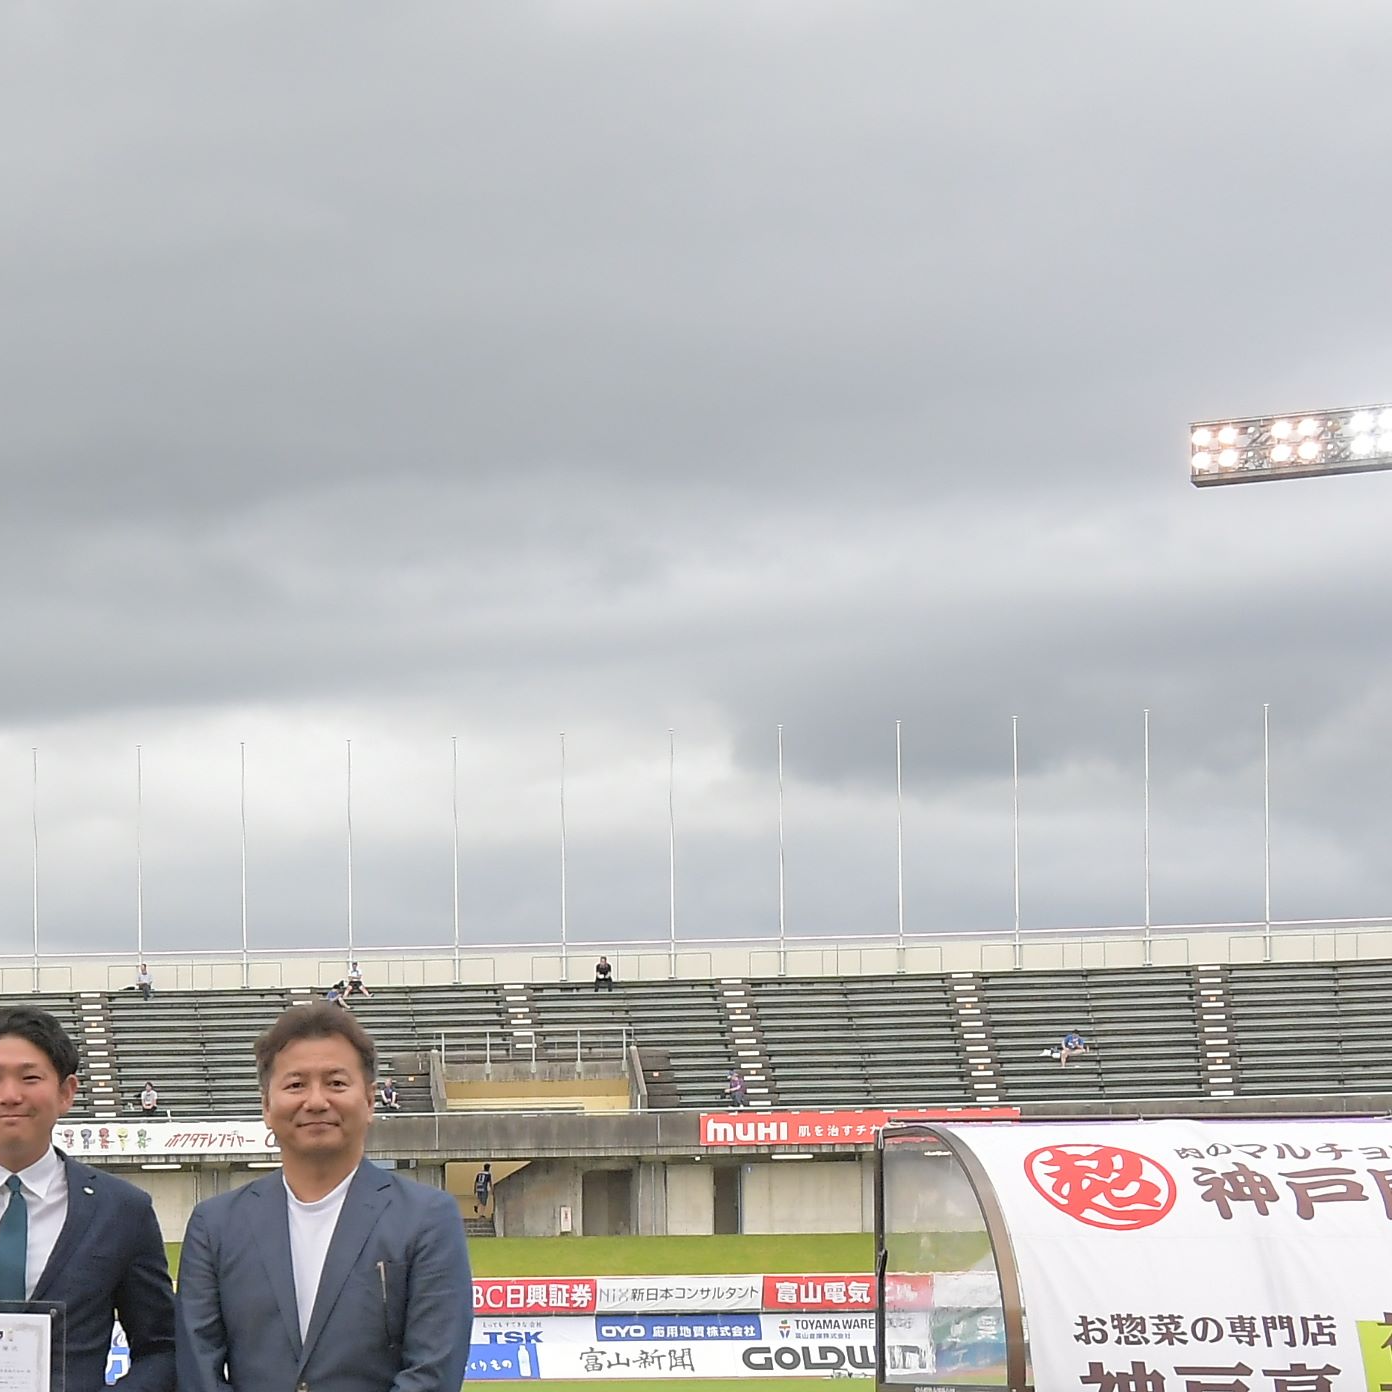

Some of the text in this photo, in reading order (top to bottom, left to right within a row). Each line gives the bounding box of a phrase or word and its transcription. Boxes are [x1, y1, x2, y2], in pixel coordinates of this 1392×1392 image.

[631, 1284, 759, 1301] 新日本コンサルタント
[776, 1282, 871, 1304] 富山電気
[601, 1325, 757, 1339] OYO 応用地質株式会社
[795, 1318, 839, 1331] TOYAMA
[1073, 1314, 1337, 1347] お惣菜の専門店
[483, 1330, 544, 1344] TSK
[579, 1347, 695, 1373] 富山新聞
